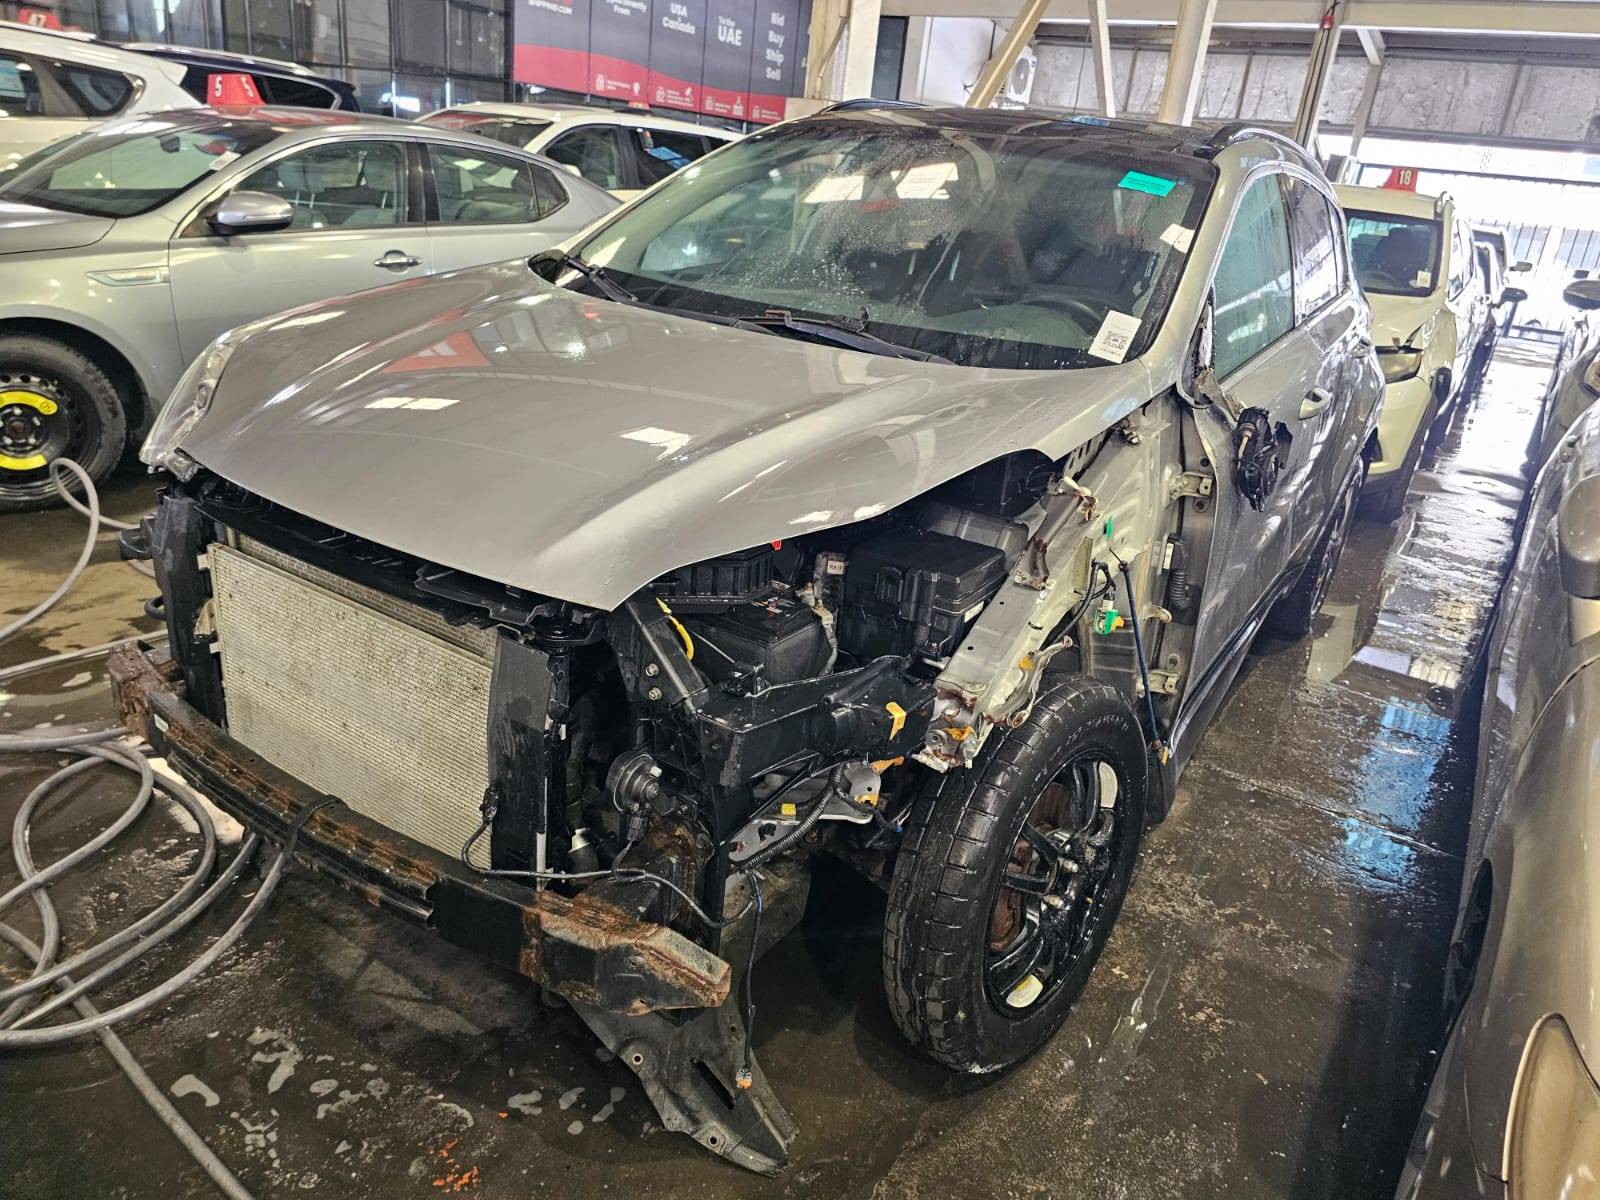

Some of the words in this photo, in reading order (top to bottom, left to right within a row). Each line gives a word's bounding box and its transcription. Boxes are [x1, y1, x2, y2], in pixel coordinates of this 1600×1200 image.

[670, 3, 688, 18] USA
[771, 12, 785, 27] Bid
[662, 16, 696, 35] Canada
[718, 25, 742, 46] UAE
[768, 30, 785, 49] Buy
[765, 48, 784, 66] Ship
[765, 67, 781, 82] Sell
[214, 76, 222, 97] 5
[1399, 169, 1412, 185] 18
